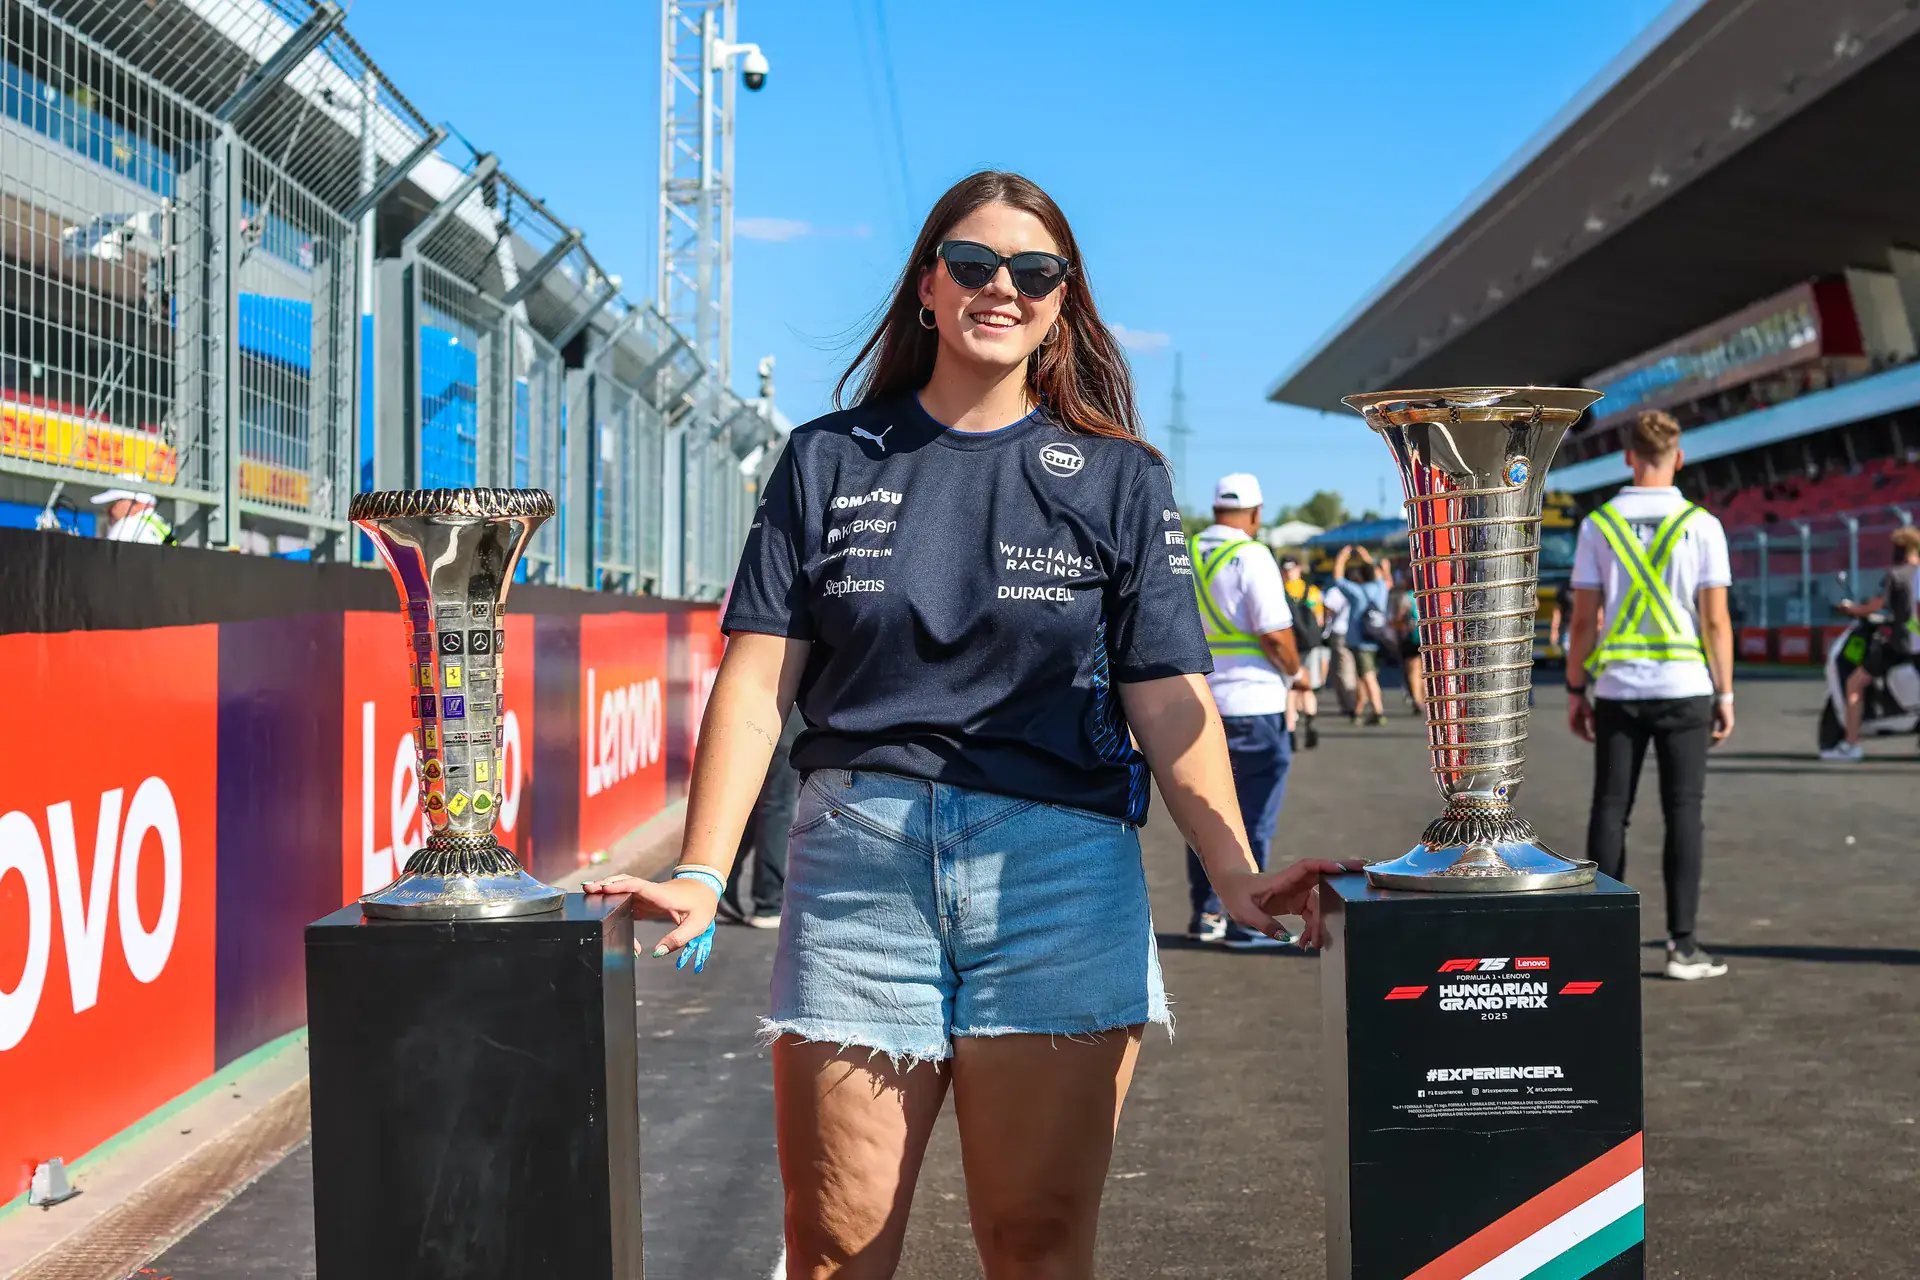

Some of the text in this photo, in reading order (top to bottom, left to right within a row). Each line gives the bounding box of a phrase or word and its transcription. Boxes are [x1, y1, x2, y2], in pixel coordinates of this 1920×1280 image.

[1042, 451, 1082, 469] Gulf
[842, 518, 897, 538] kraken
[999, 541, 1094, 570] WILLIAMS
[1006, 559, 1082, 578] RACING
[823, 575, 885, 598] Stephens
[997, 585, 1075, 602] DURACELL
[586, 668, 662, 797] Lenovo
[362, 701, 522, 895] Leo
[1439, 982, 1548, 998] HUNGARIAN
[1439, 996, 1548, 1011] GRAND PRIX
[1481, 1012, 1508, 1020] 2025
[1426, 1066, 1564, 1082] #EXPERIENCEF1
